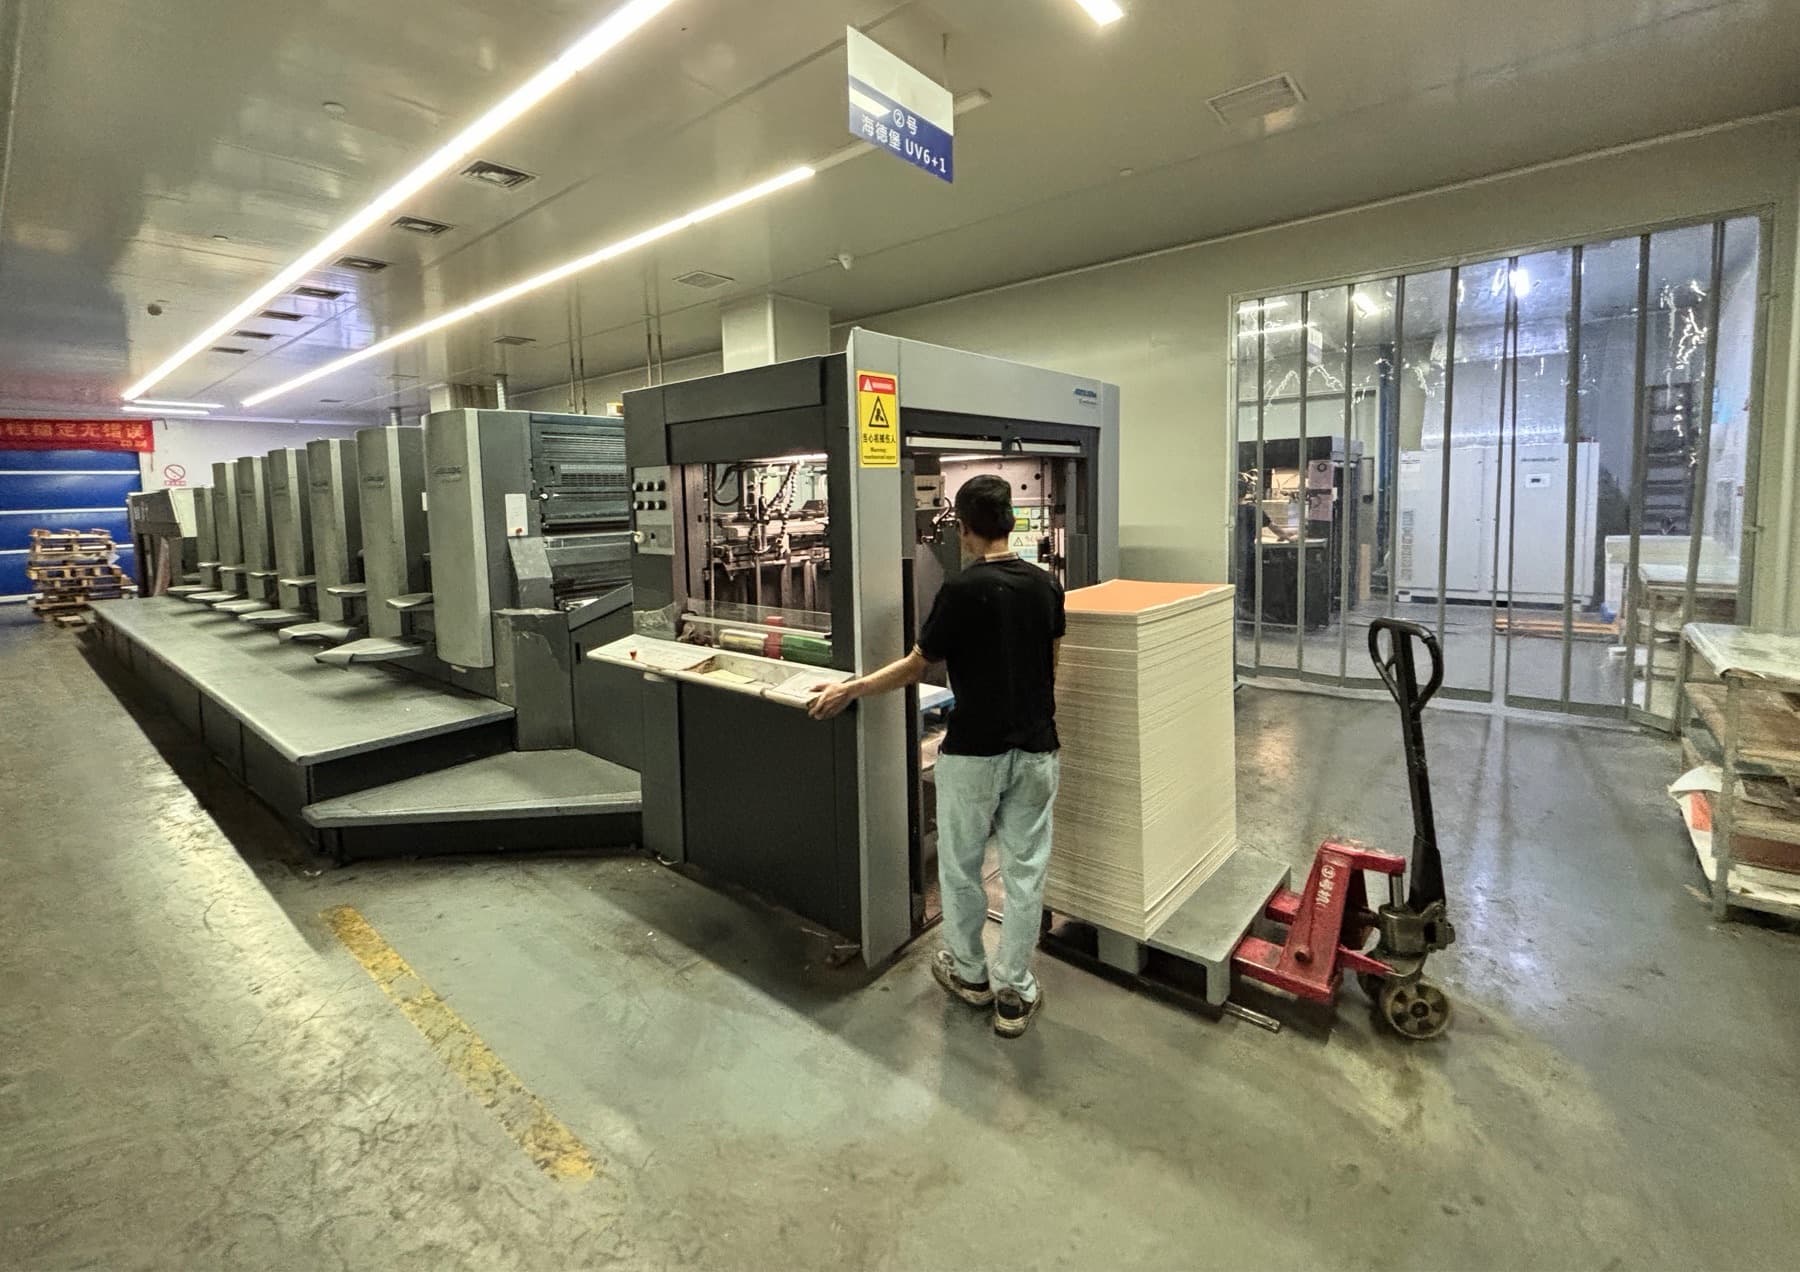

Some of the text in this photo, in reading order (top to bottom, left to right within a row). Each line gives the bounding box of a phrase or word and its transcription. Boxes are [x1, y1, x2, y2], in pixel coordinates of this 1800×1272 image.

[861, 113, 947, 174] 海德堡 UV6+1
[893, 108, 918, 136] ②号
